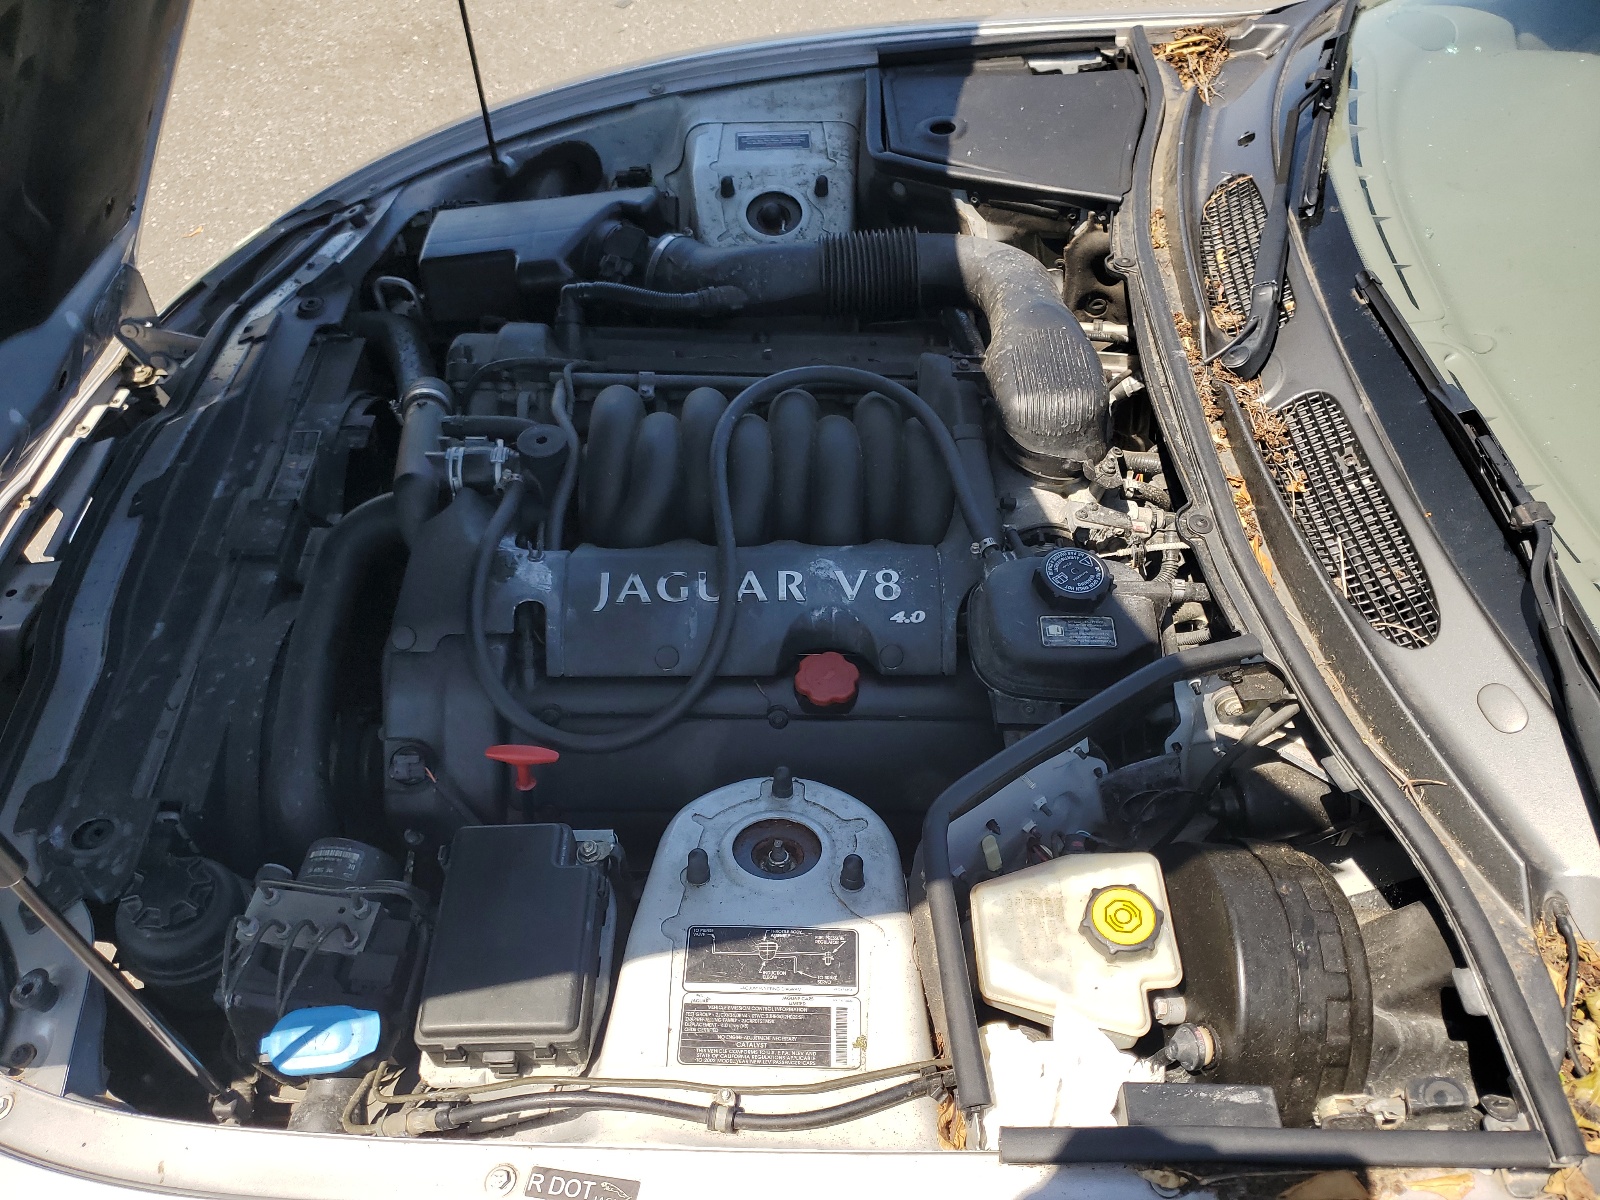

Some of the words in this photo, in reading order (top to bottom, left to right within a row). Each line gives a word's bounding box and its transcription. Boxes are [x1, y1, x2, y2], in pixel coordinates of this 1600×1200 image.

[593, 570, 807, 612] JAGUAR
[833, 568, 902, 602] V8
[889, 609, 926, 624] 4.0
[736, 1041, 768, 1049] CATALYST
[527, 1173, 545, 1193] R
[548, 1176, 597, 1200] DOT
